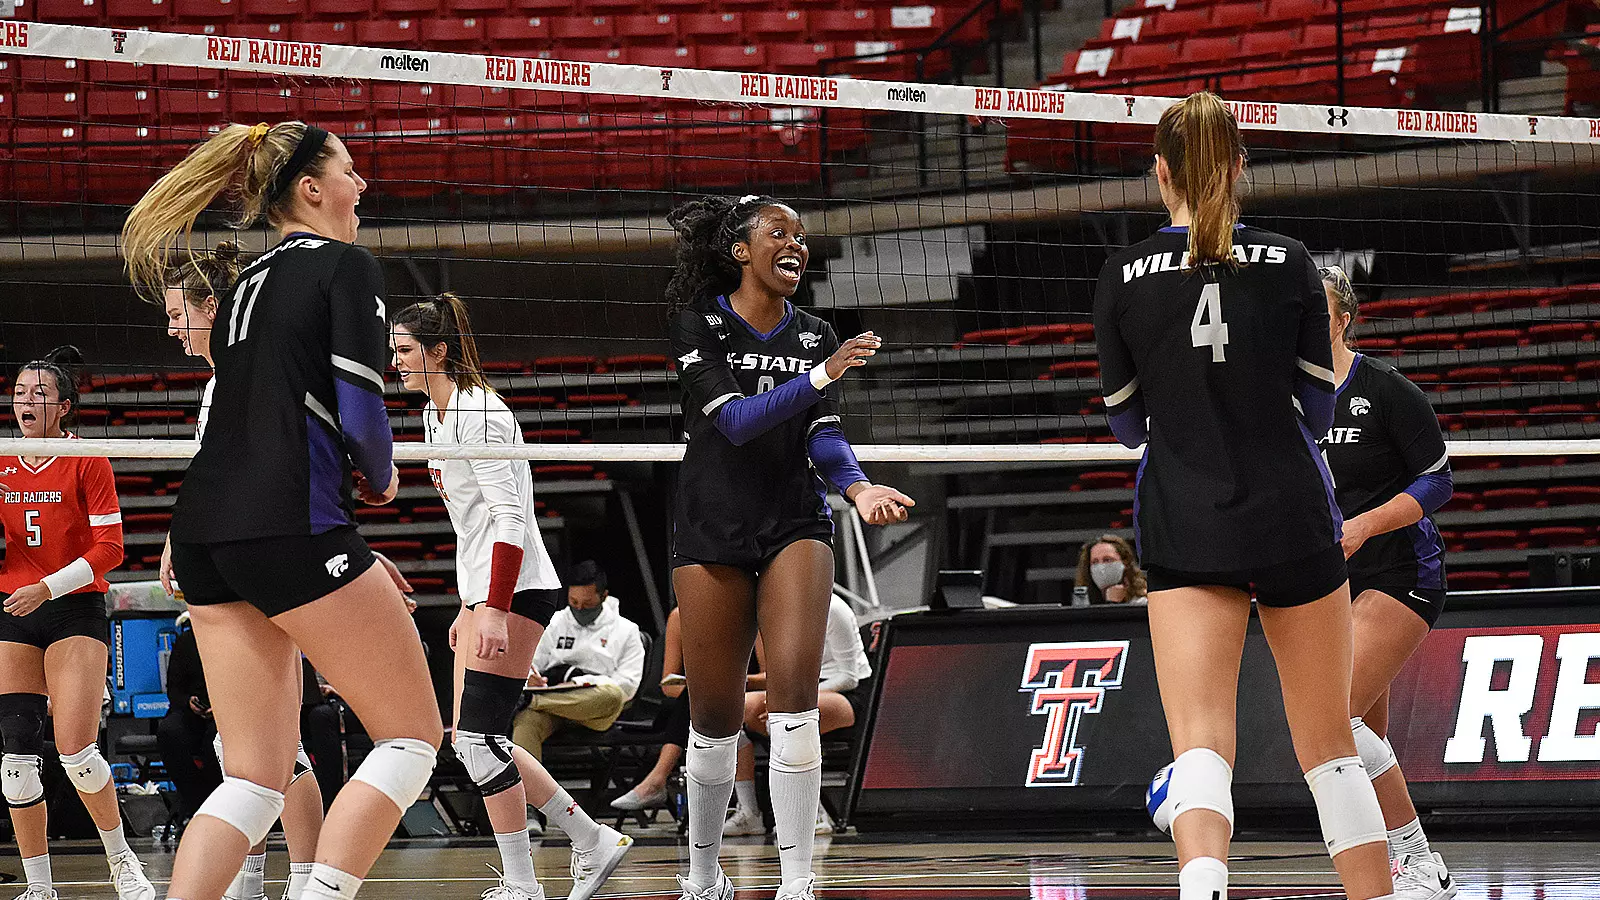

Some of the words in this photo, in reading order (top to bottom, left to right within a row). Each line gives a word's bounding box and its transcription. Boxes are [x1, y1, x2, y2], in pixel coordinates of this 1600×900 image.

[207, 38, 240, 62] RED
[249, 41, 322, 68] RAIDERS
[381, 54, 428, 72] molten
[485, 57, 516, 82] RED
[521, 60, 590, 87] RAIDERS
[740, 74, 769, 97] RED
[774, 77, 838, 101] RAIDERS
[887, 87, 926, 103] molten
[974, 89, 1001, 111] RED
[1007, 92, 1065, 114] RAIDERS
[1397, 111, 1421, 131] RED
[1425, 113, 1477, 134] RAIDERS
[1122, 244, 1288, 284] WILATS
[228, 267, 271, 348] 17
[1190, 282, 1229, 363] 4
[1314, 427, 1362, 445] ATE
[4, 491, 21, 504] RED
[22, 490, 62, 503] RAIDERS
[24, 509, 42, 547] 5
[115, 624, 124, 688] POWERADE
[1442, 632, 1600, 764] RE
